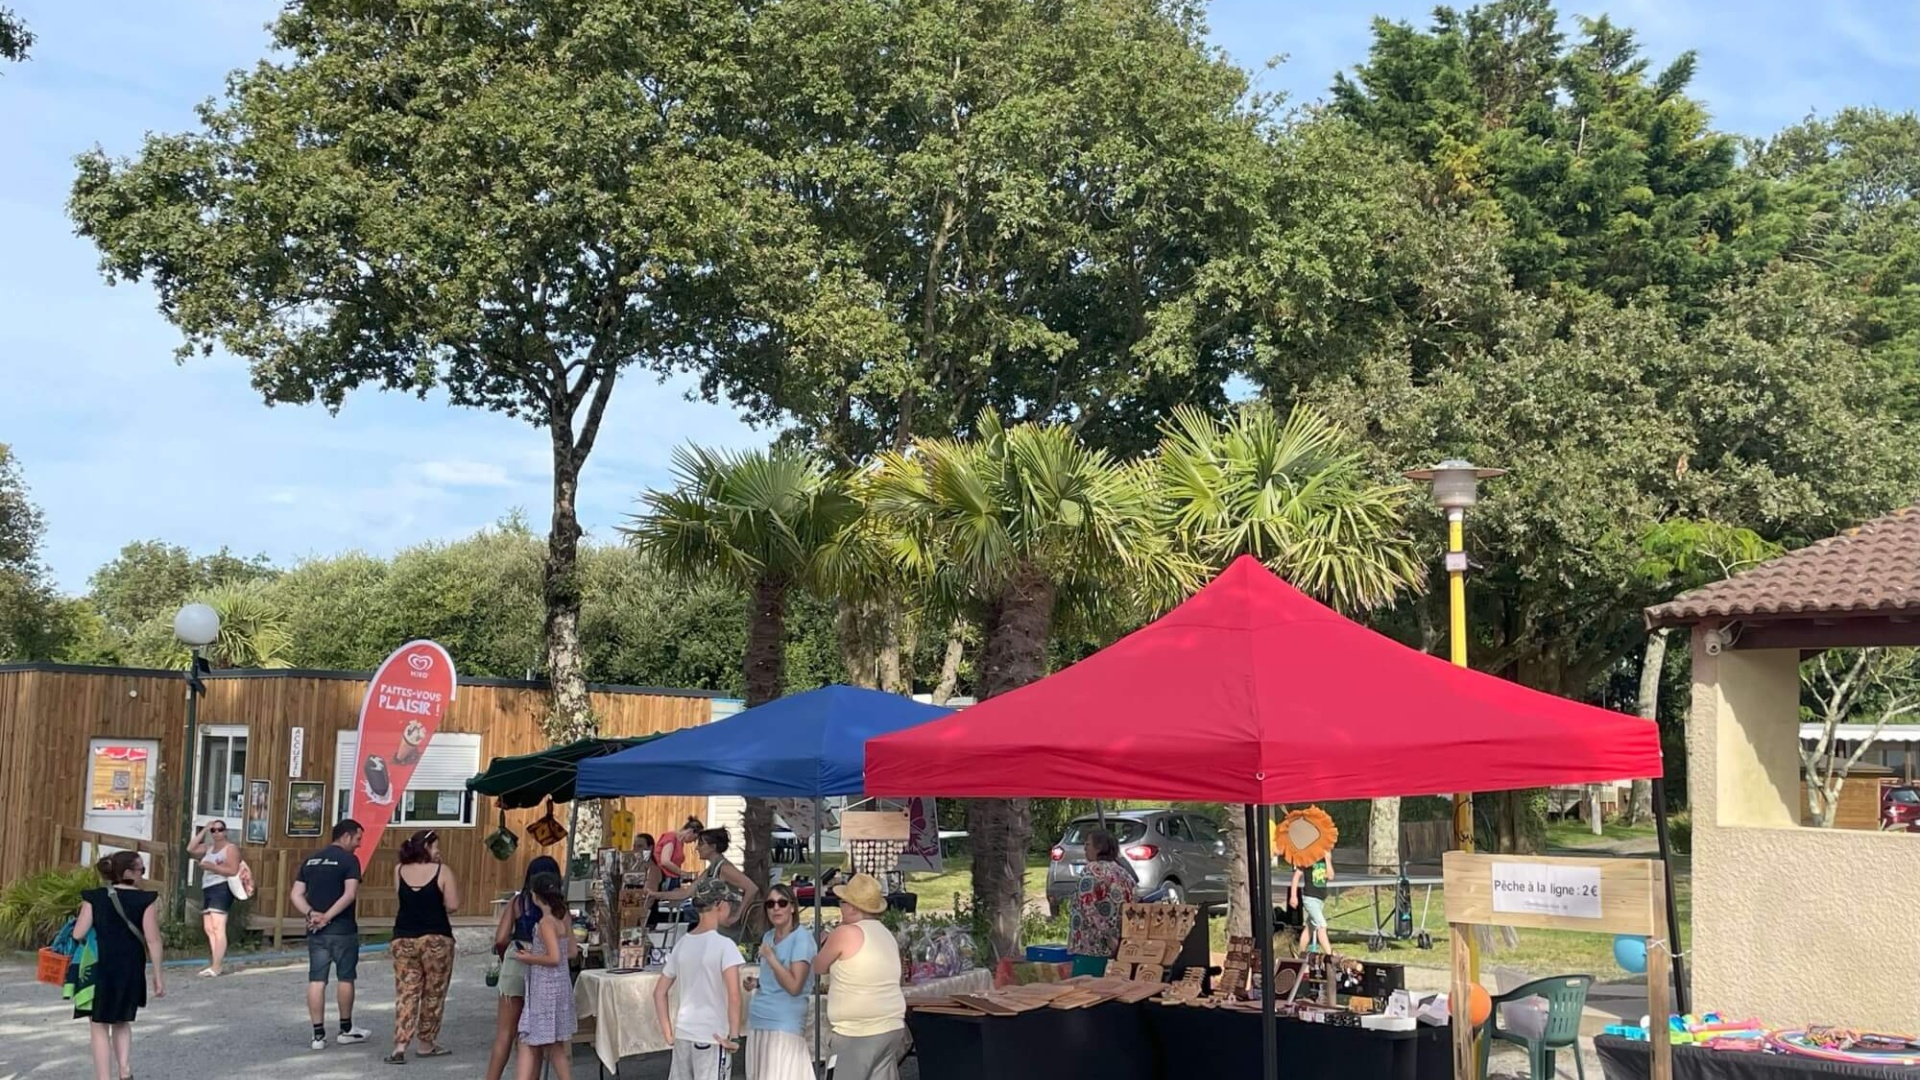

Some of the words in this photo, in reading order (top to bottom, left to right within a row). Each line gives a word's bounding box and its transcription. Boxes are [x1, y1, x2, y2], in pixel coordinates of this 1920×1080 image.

[380, 684, 442, 702] FAITES-VOUS
[379, 694, 431, 716] PLAISIR
[435, 703, 441, 717] !
[293, 728, 301, 776] ACCUEIL
[1494, 880, 1525, 892] Pêche
[1528, 881, 1534, 893] à
[1537, 881, 1546, 893] la
[1550, 883, 1575, 897] ligne
